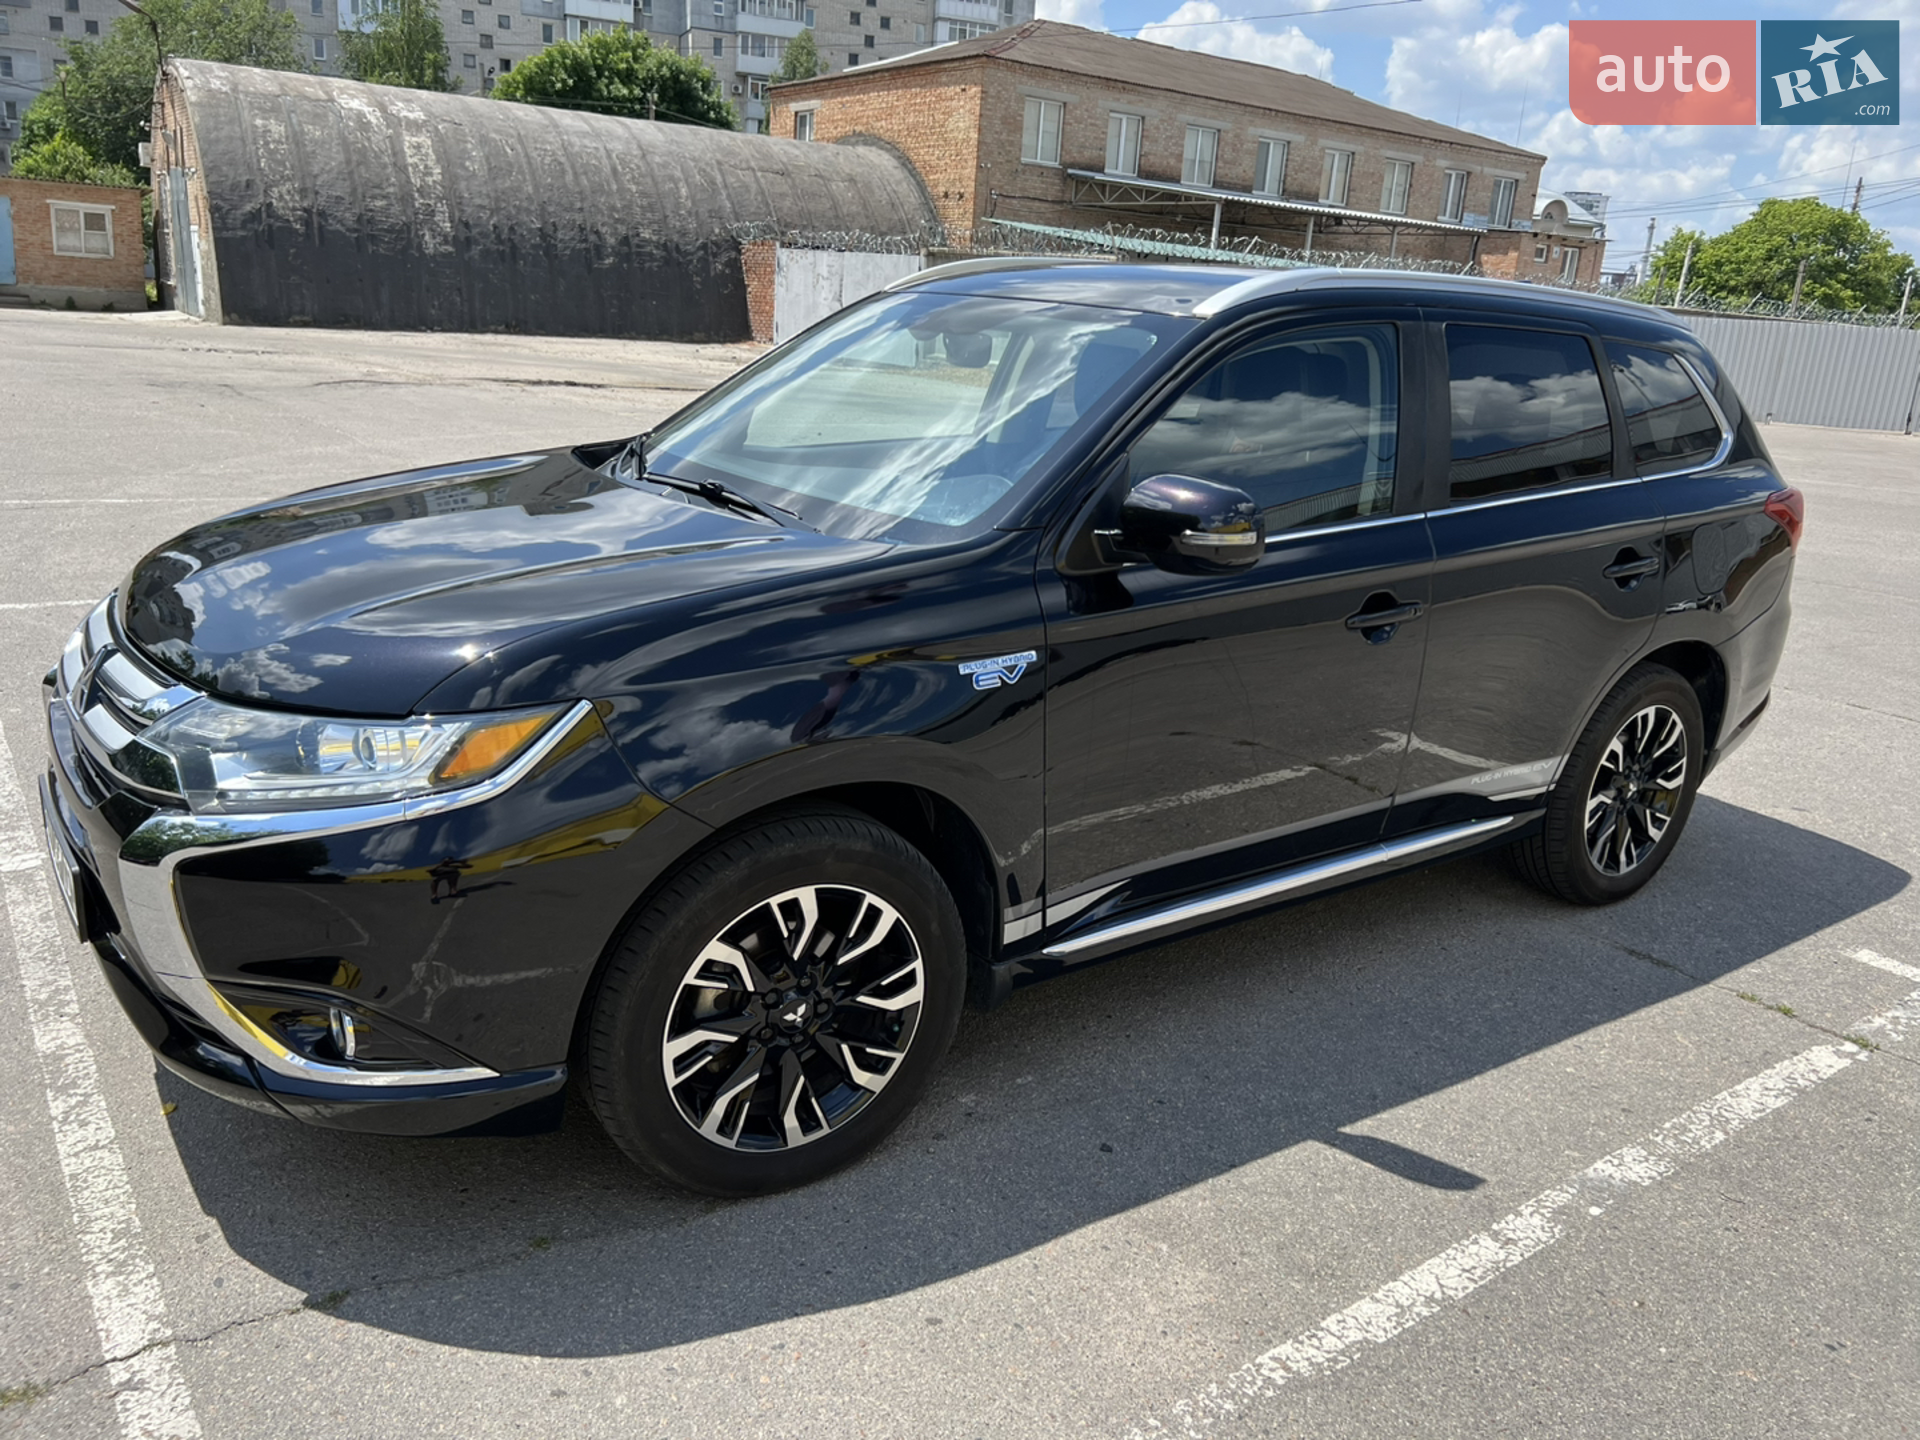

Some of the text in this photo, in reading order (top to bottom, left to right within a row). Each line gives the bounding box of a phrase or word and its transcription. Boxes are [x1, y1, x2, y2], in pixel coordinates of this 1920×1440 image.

[962, 652, 1034, 673] PLUG-IN HYBRID
[973, 664, 1026, 690] EV
